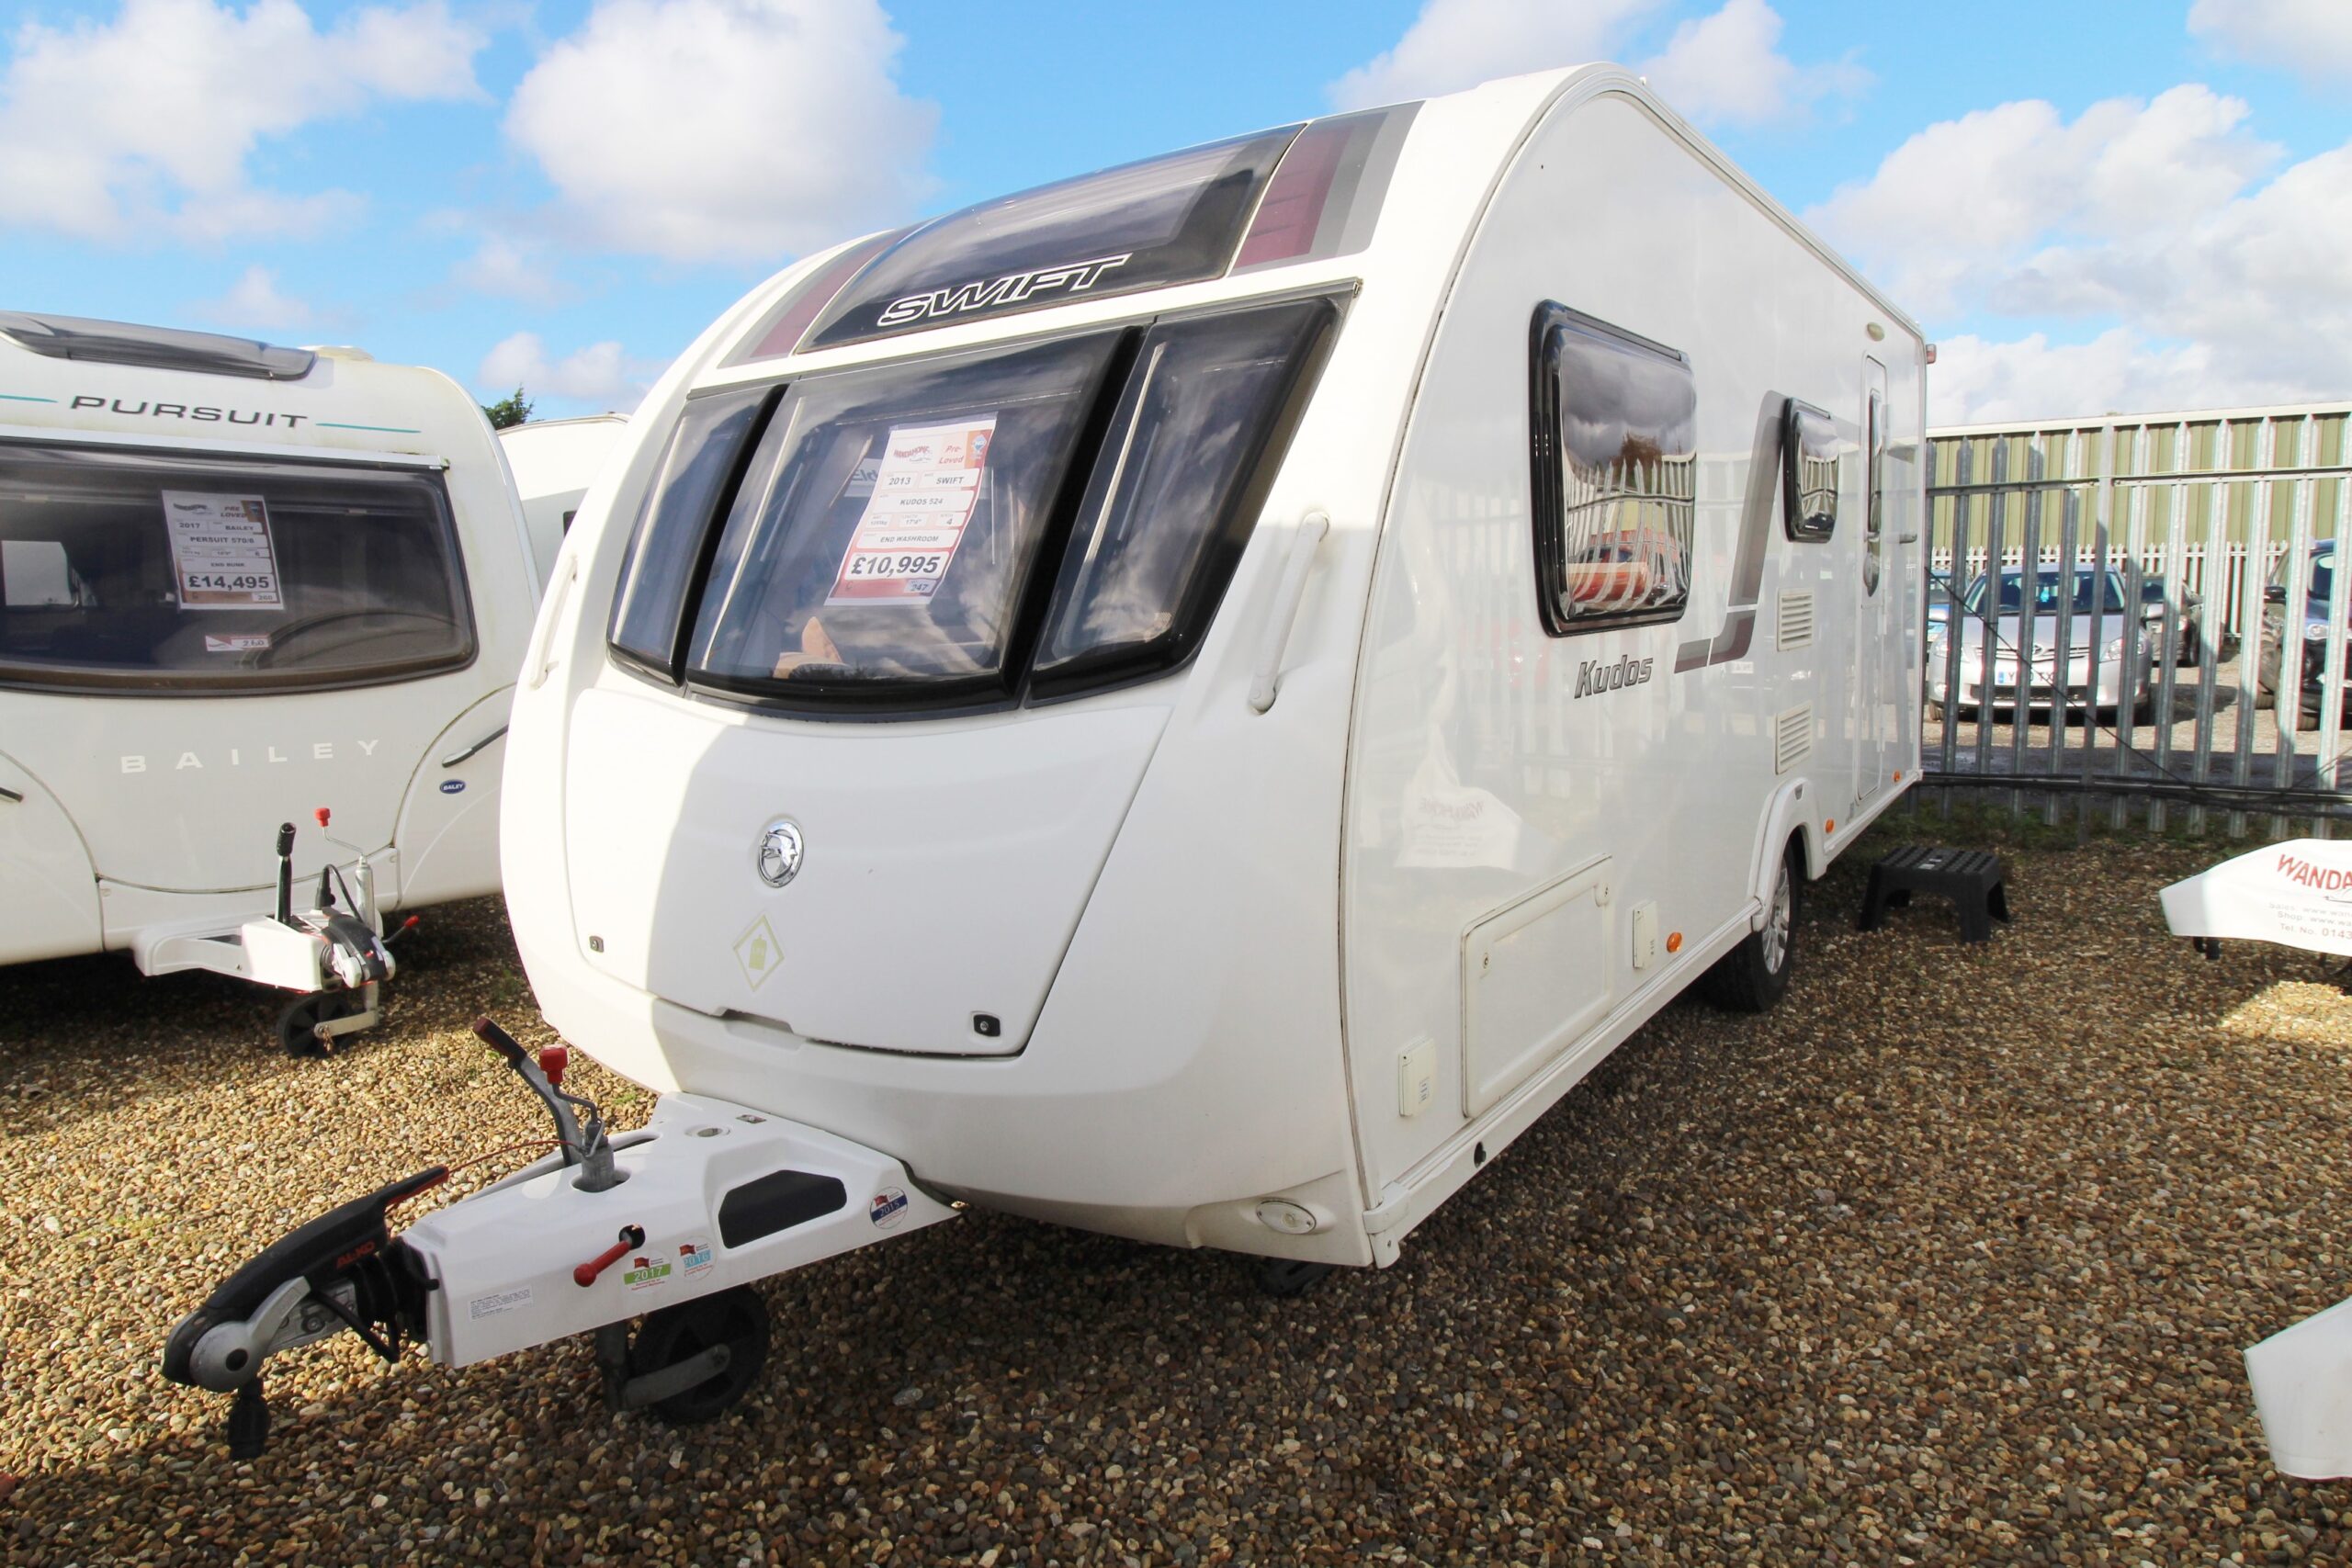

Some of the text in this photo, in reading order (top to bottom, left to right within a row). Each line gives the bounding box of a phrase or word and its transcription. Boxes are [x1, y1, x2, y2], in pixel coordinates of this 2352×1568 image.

[876, 253, 1133, 326] SWIFT
[70, 395, 309, 428] PURSUIT
[888, 477, 911, 486] 2013
[935, 476, 965, 485] SWIFT
[899, 497, 944, 505] KUDOS 524
[946, 517, 953, 525] 4
[850, 555, 941, 578] £10,995
[188, 575, 270, 592] £14,495
[910, 583, 929, 592] 247
[1574, 653, 1654, 699] Kudos
[120, 739, 379, 774] BAILEY
[634, 1267, 662, 1282] 2017
